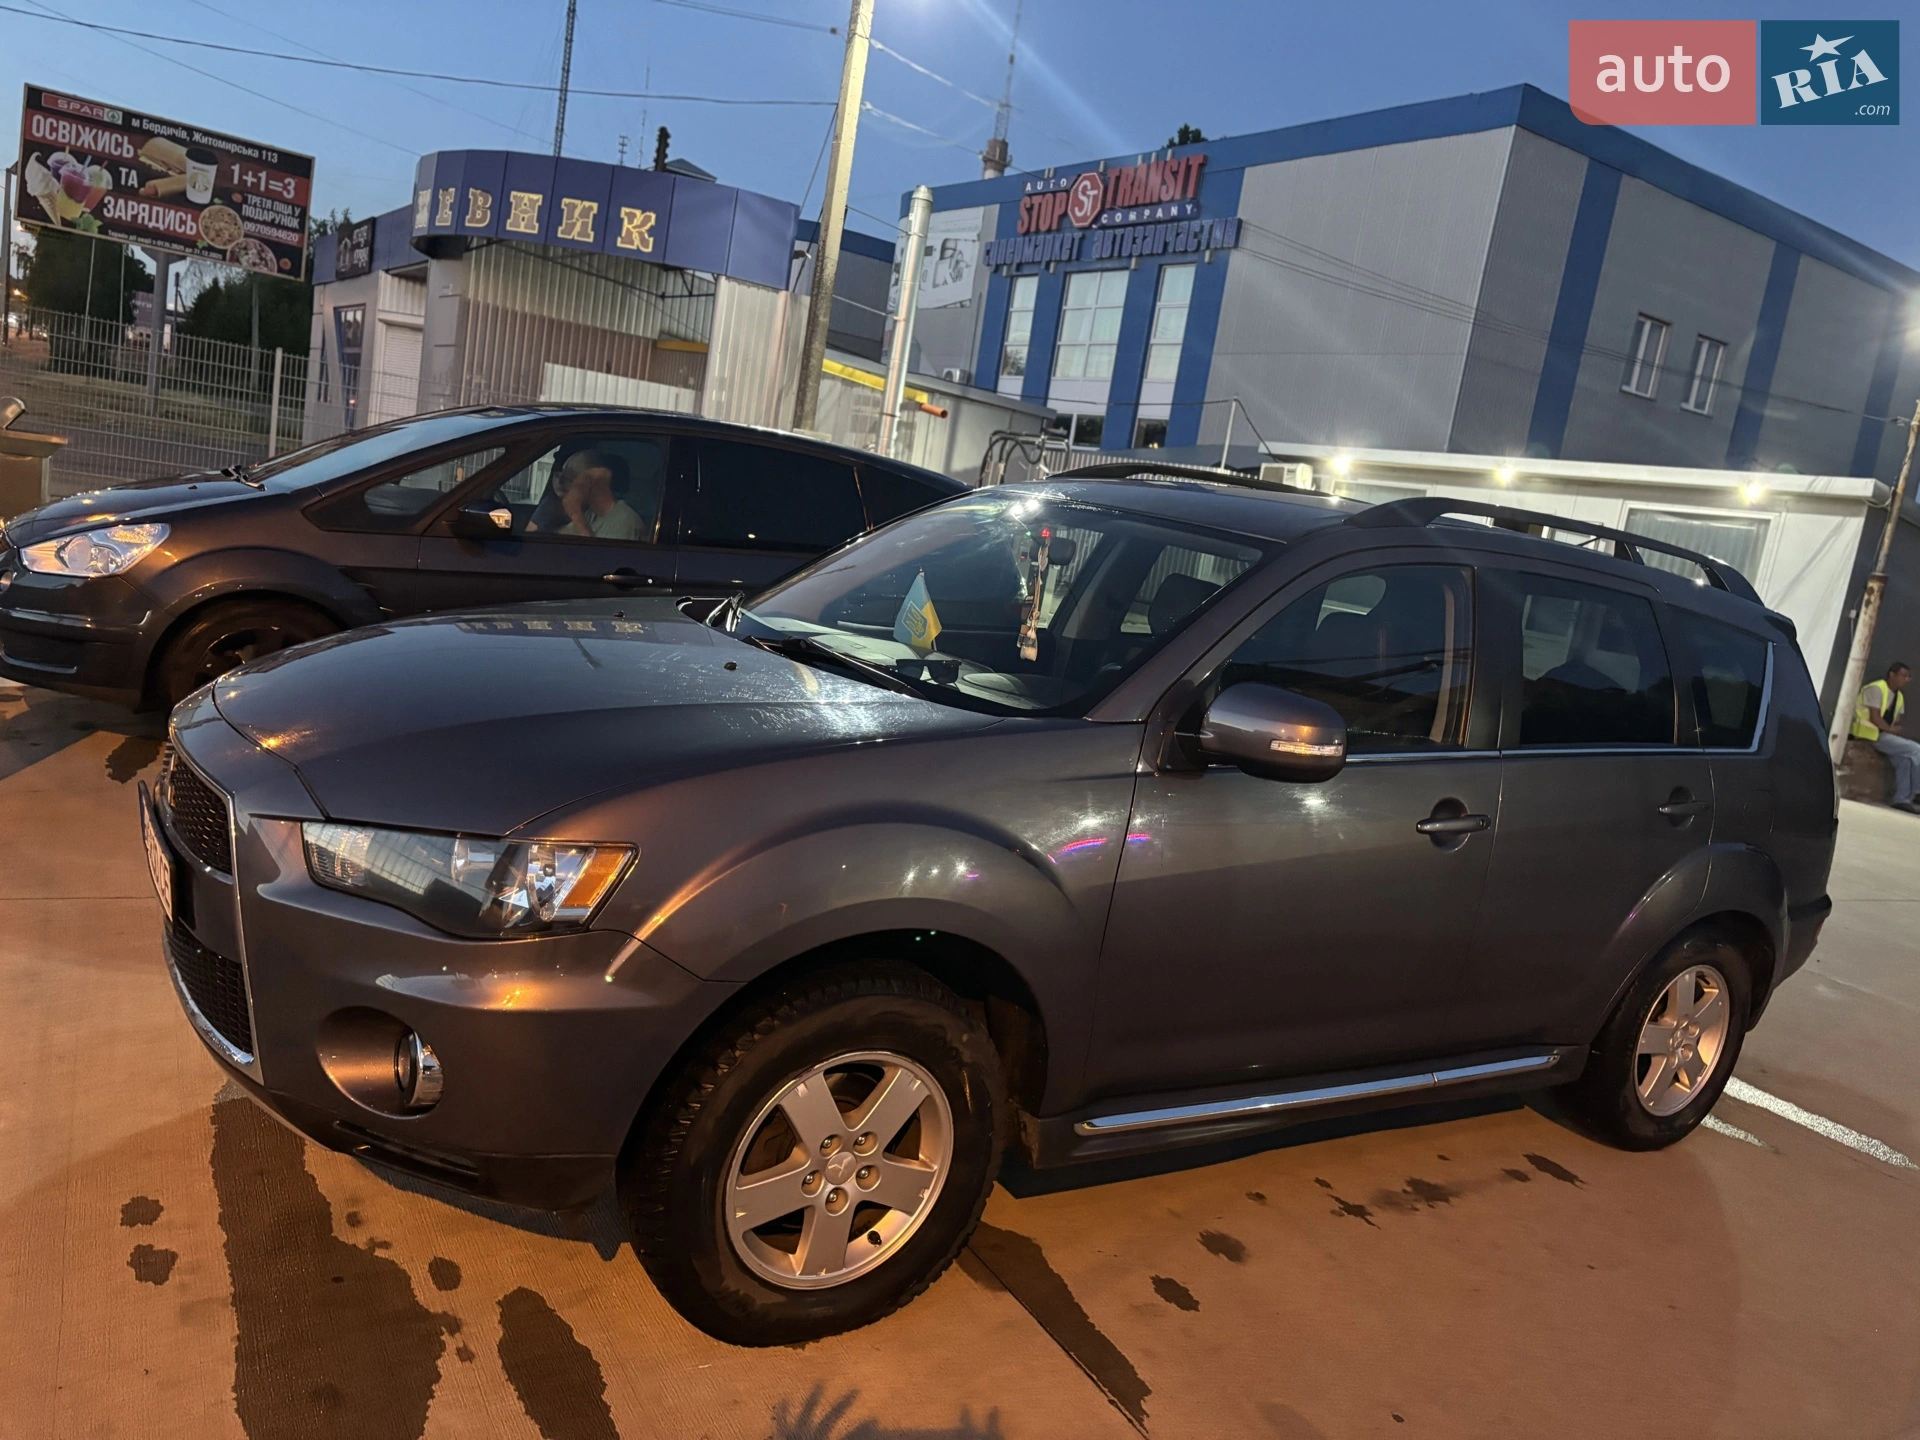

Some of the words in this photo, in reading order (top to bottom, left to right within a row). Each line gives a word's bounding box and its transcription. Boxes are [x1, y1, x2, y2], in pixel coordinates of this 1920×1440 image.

[57, 99, 104, 117] SPAR
[32, 114, 134, 158] ОСВІЖИСЬ
[142, 119, 190, 141] Бердичів,
[193, 131, 259, 157] Житомирська
[261, 150, 278, 163] 113
[119, 167, 138, 188] ТА
[1025, 178, 1067, 191] AUTO
[1017, 192, 1068, 235] STOP
[1105, 154, 1204, 208] TRANSIT
[103, 196, 197, 235] ЗАРЯДИСЬ
[242, 204, 300, 229] ПОДАРУНОК
[294, 206, 301, 217] У
[1101, 204, 1193, 224] COMPANY
